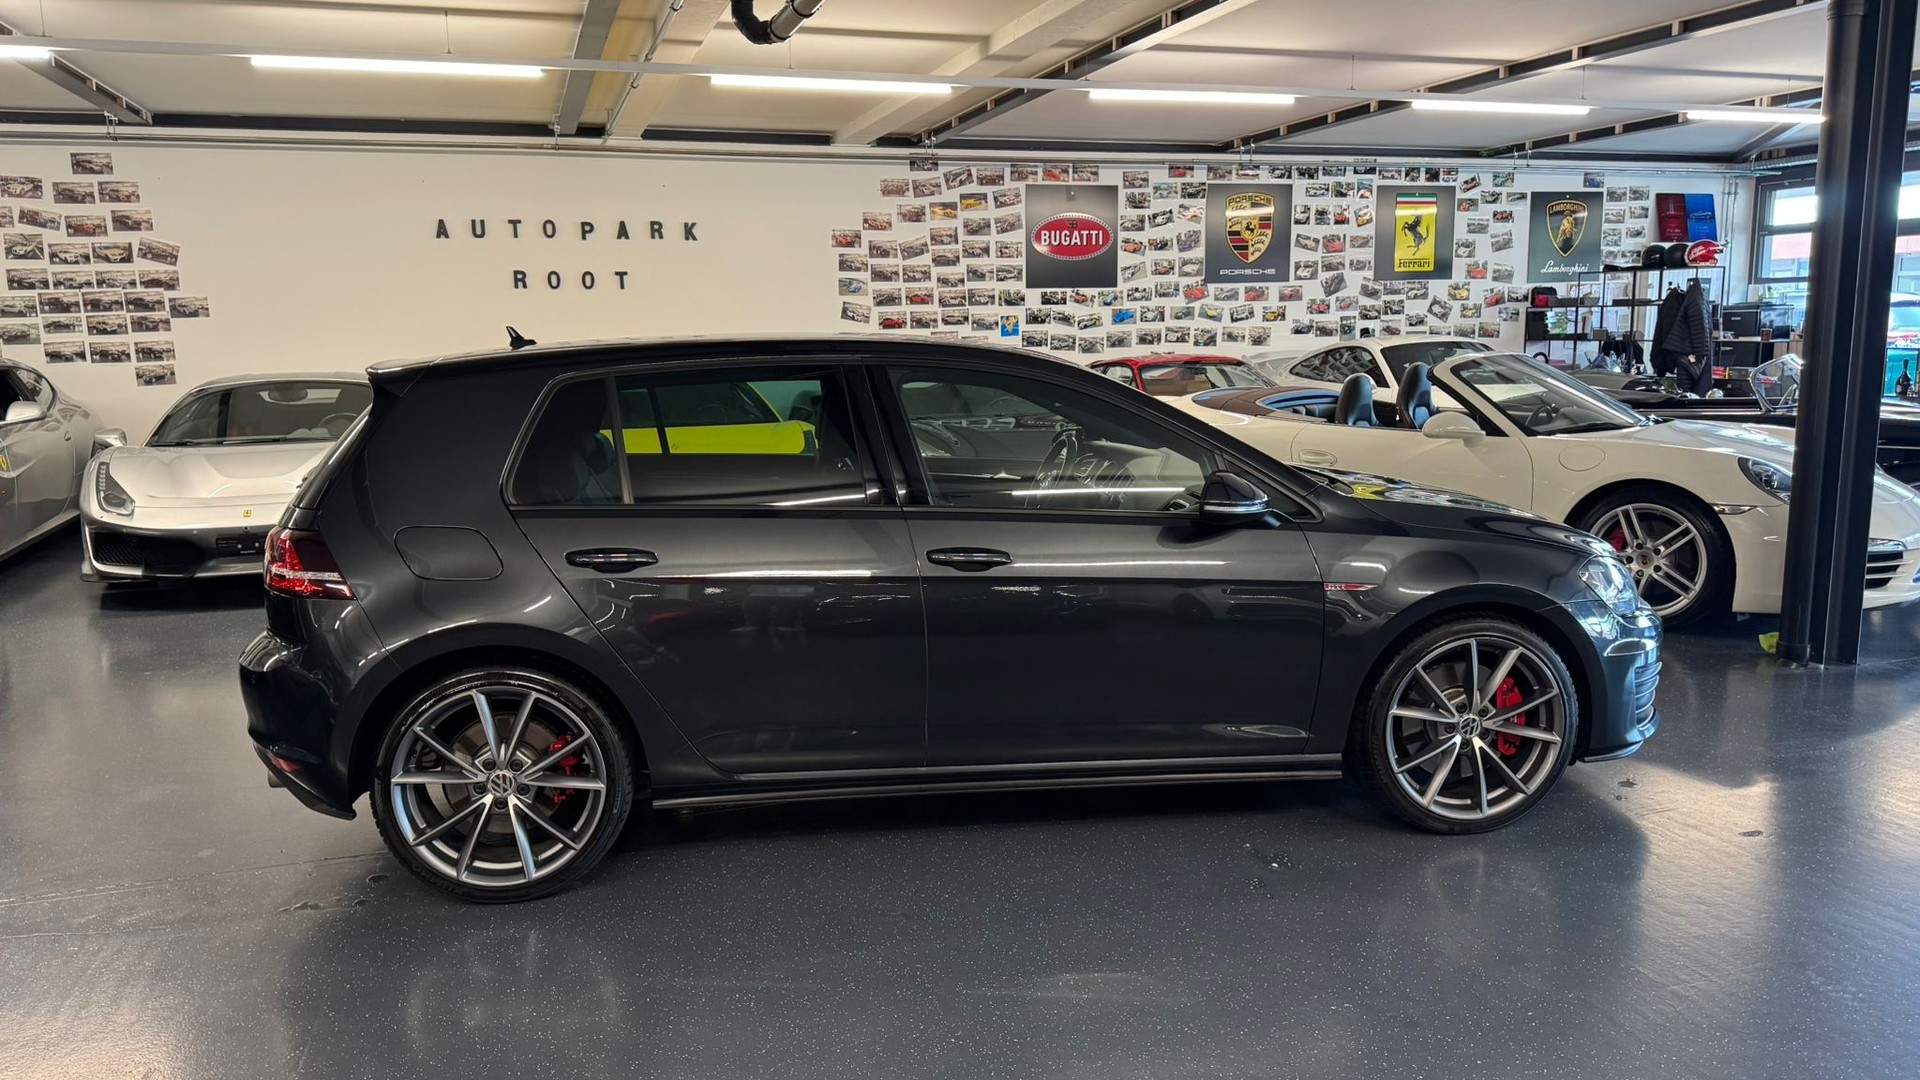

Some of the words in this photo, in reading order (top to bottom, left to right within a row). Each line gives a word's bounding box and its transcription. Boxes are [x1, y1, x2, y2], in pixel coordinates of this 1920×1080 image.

[1228, 194, 1272, 205] PORSCHE
[436, 219, 698, 241] AUTOPARK
[1041, 230, 1103, 246] BUGATTI
[1398, 258, 1430, 268] Ferrari
[1540, 260, 1590, 275] Lamborghini
[513, 270, 628, 290] ROOT
